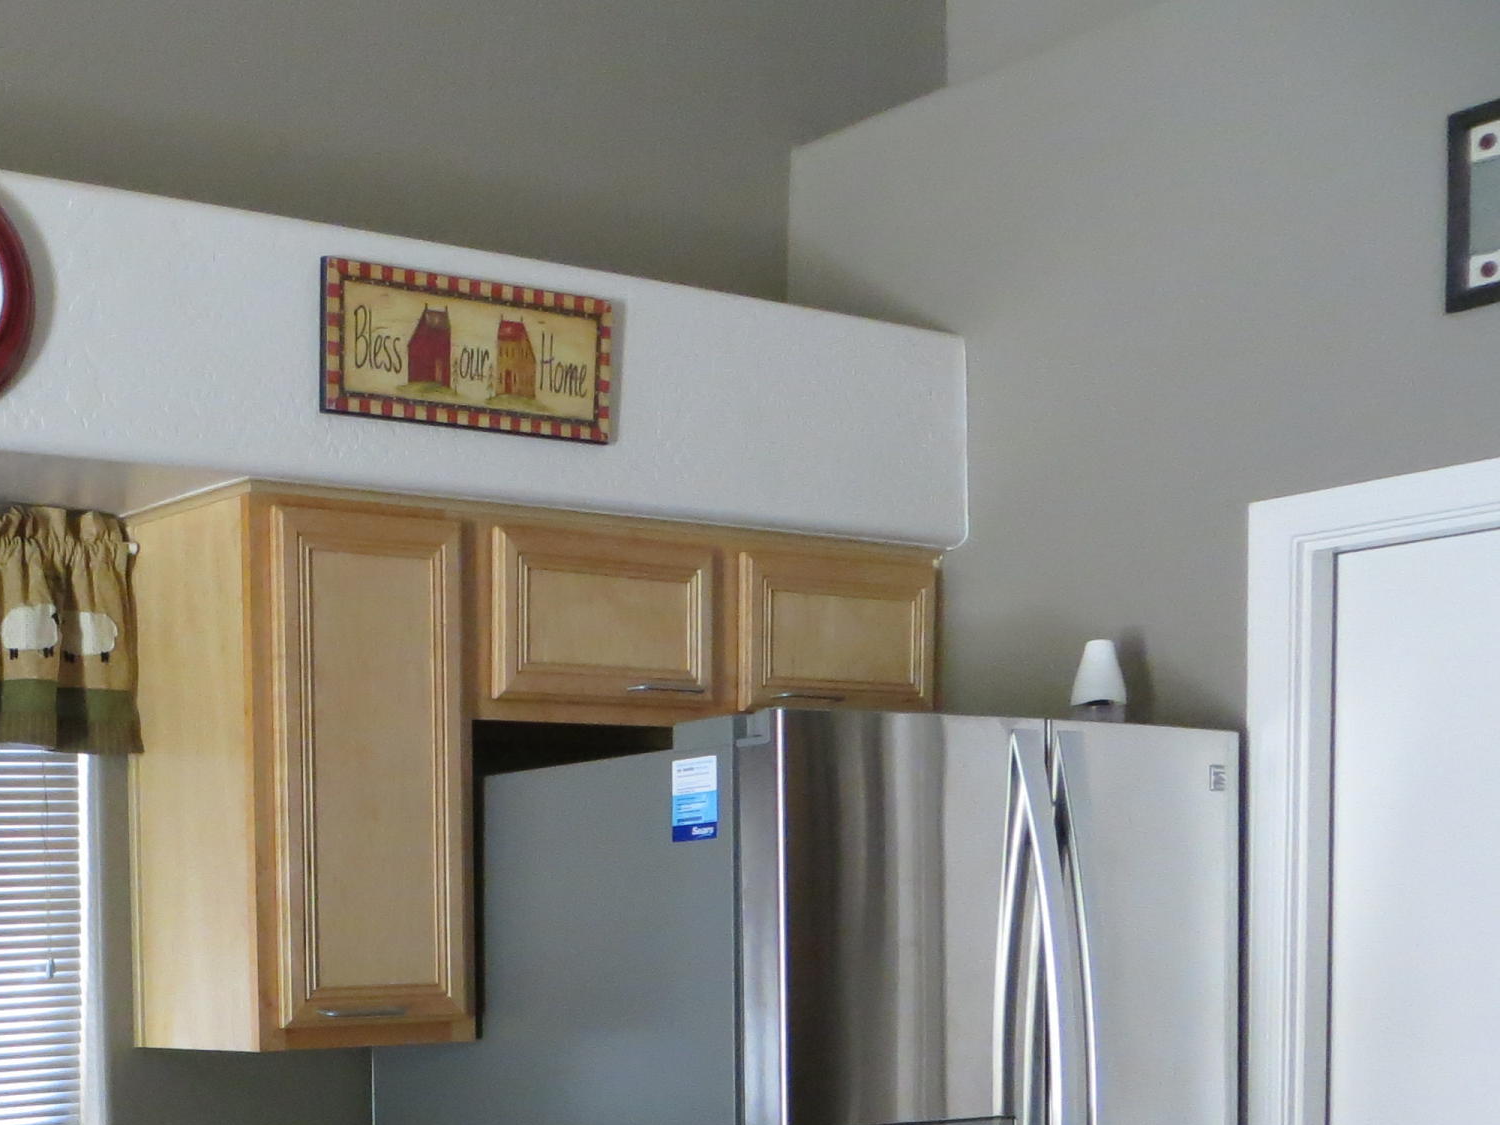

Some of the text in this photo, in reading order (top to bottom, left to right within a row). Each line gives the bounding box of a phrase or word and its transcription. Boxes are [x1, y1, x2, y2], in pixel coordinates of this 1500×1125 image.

[353, 304, 588, 399] Bless our Home
